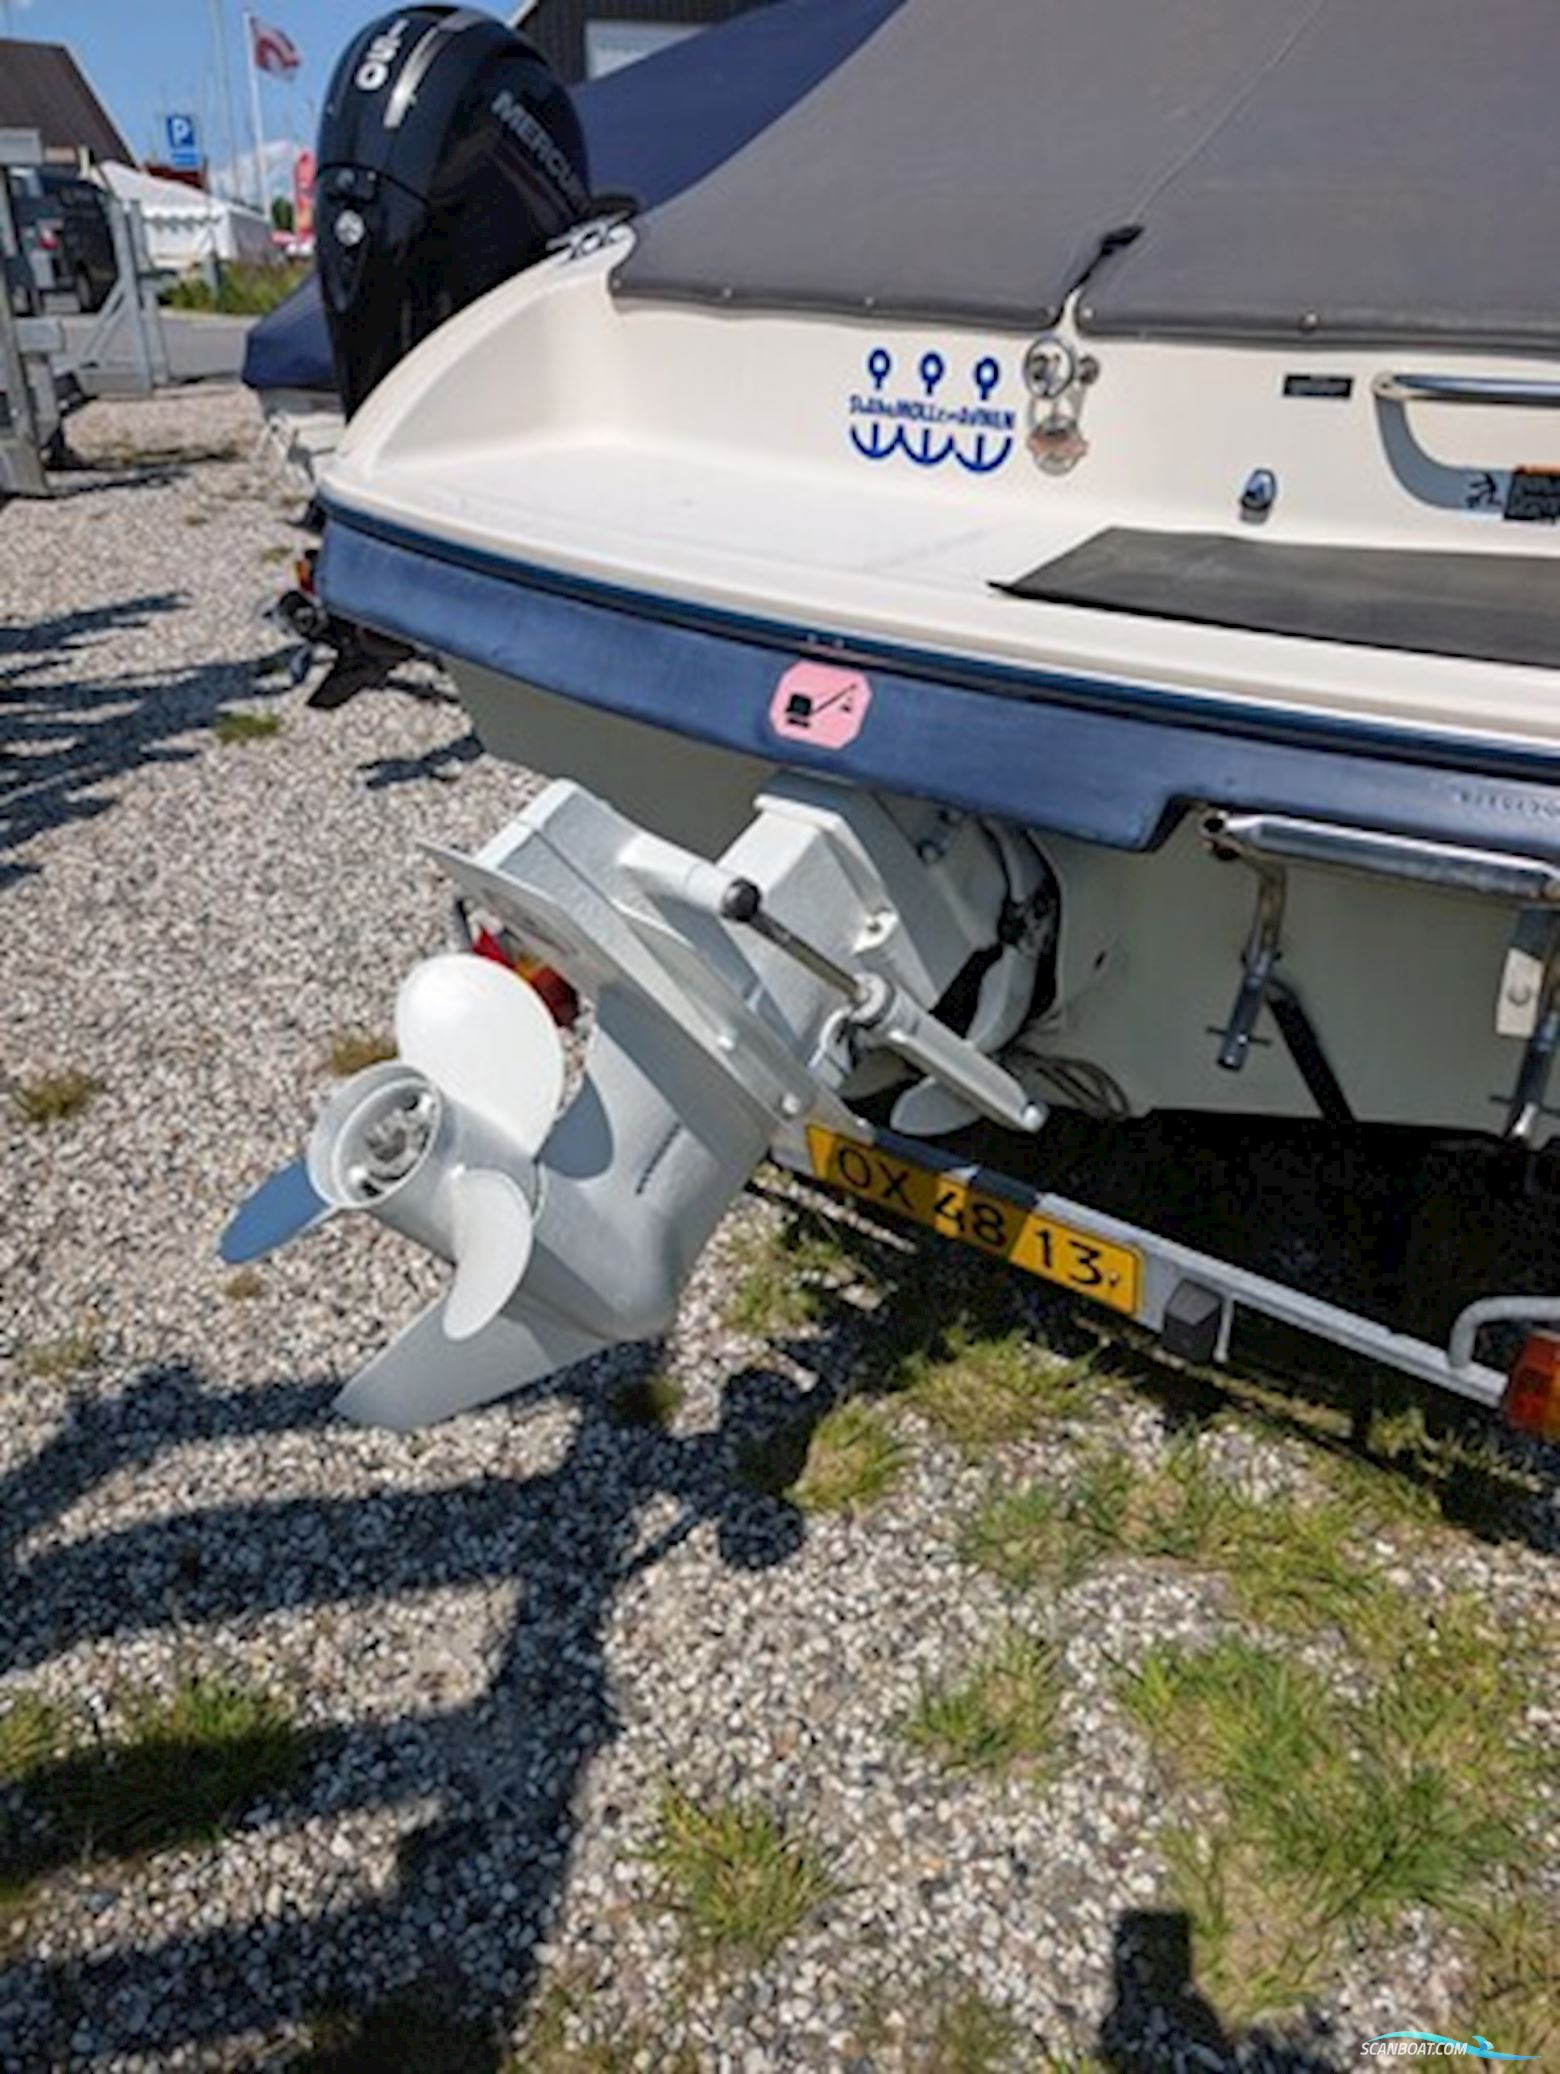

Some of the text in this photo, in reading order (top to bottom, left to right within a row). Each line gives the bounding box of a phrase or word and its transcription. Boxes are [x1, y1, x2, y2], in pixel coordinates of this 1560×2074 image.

[172, 118, 190, 147] P
[837, 1148, 1103, 1286] OX 48 13
